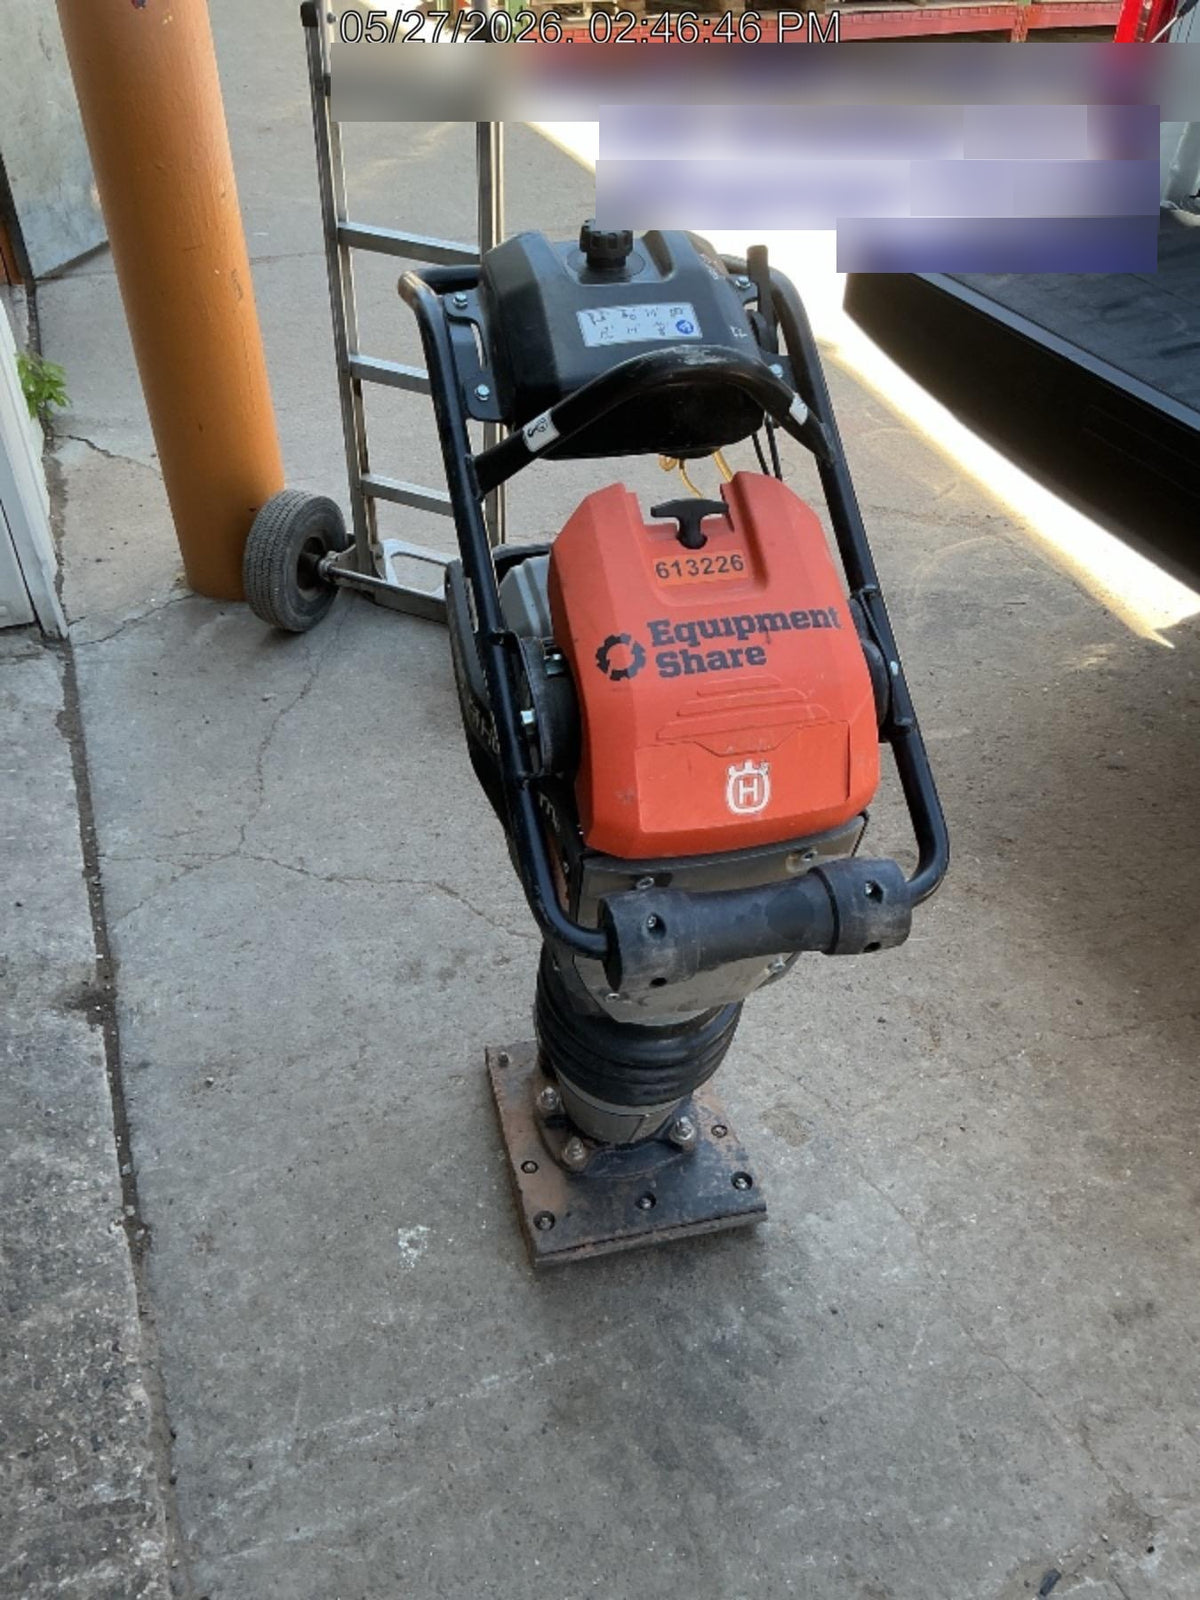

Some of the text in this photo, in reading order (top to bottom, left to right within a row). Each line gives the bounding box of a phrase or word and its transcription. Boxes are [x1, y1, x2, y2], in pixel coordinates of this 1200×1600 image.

[655, 554, 744, 579] 613226
[647, 606, 842, 648] Equipment
[655, 645, 767, 678] Share
